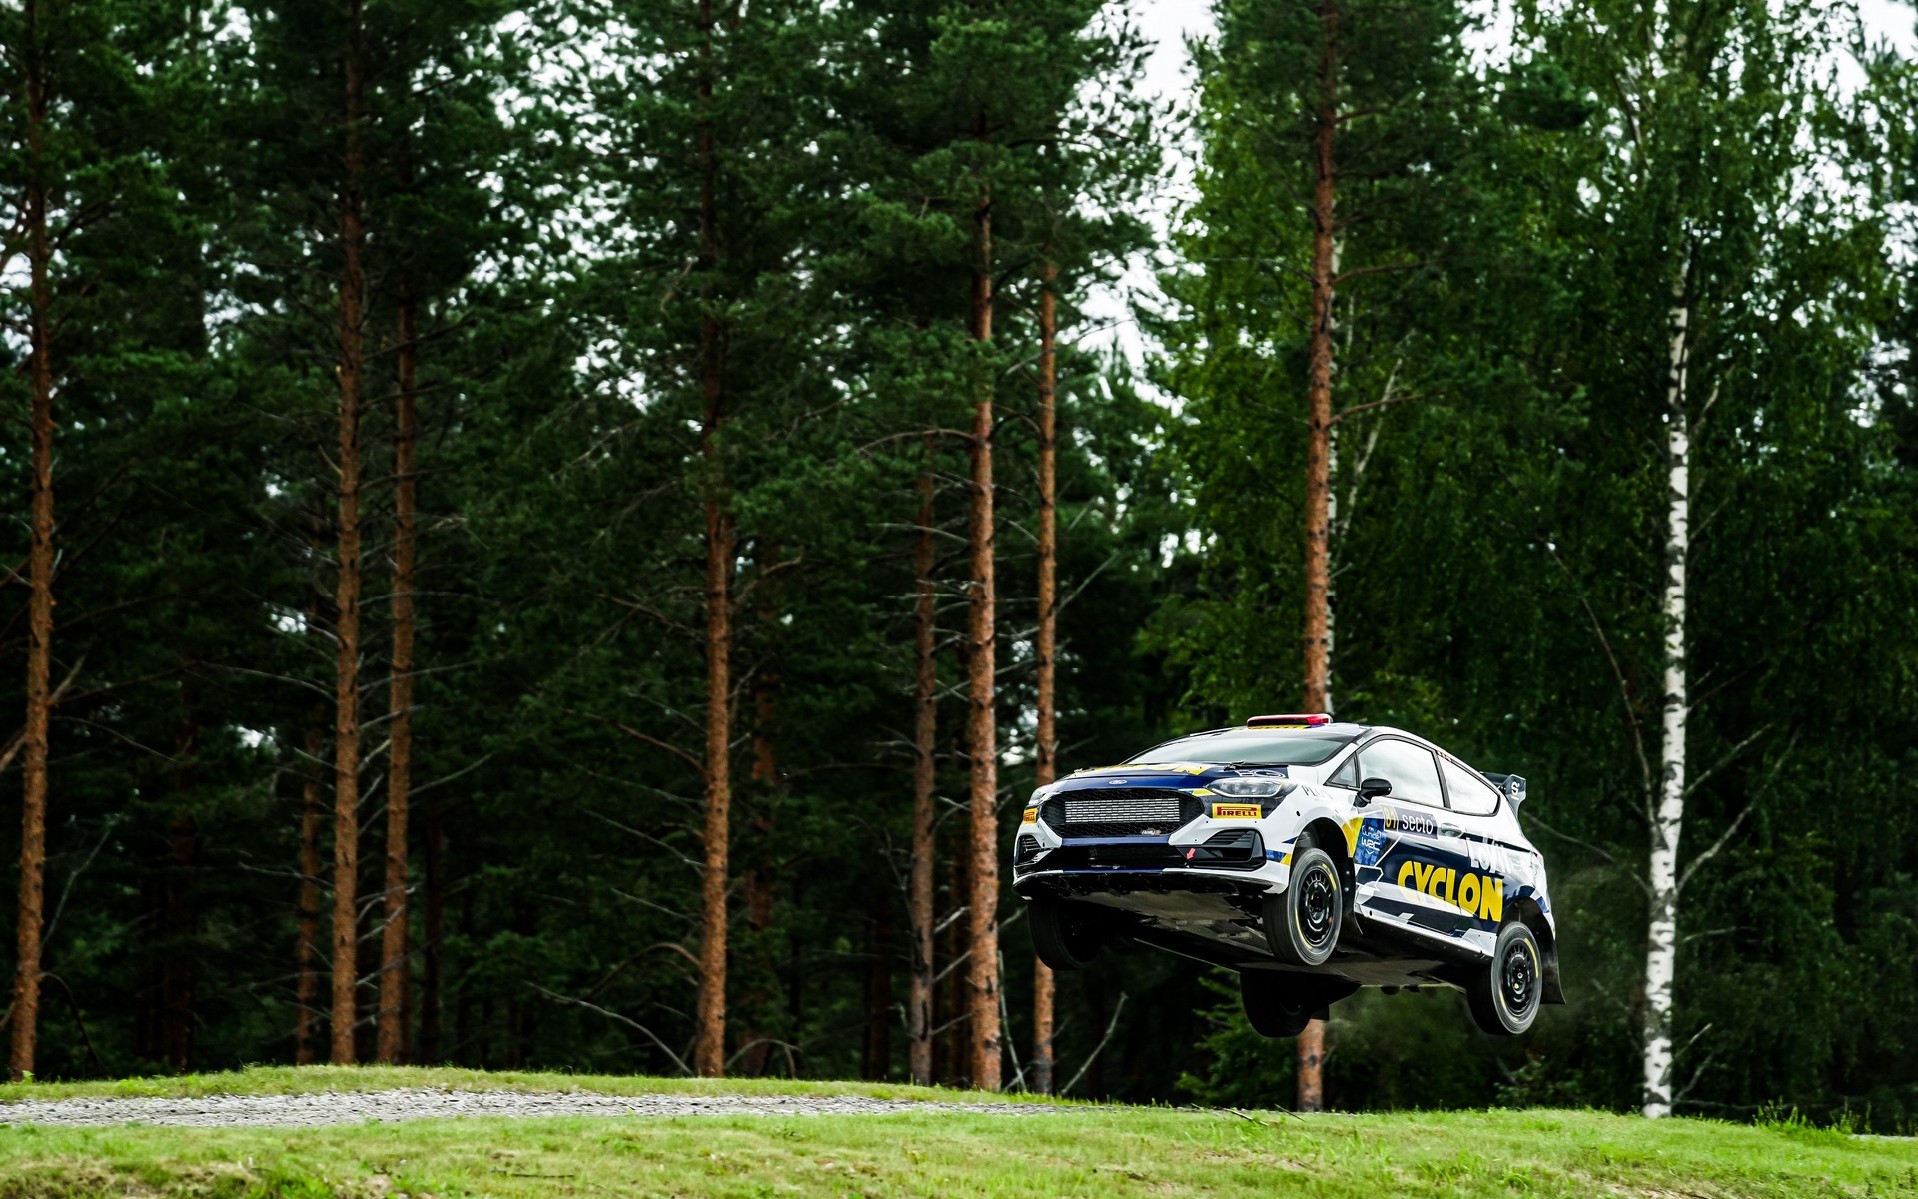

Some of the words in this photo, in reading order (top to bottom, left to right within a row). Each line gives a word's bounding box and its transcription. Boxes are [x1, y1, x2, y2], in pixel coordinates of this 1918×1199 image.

[1217, 806, 1257, 817] PIRELLI
[1402, 814, 1434, 835] secto
[1397, 860, 1503, 923] CYCLON
